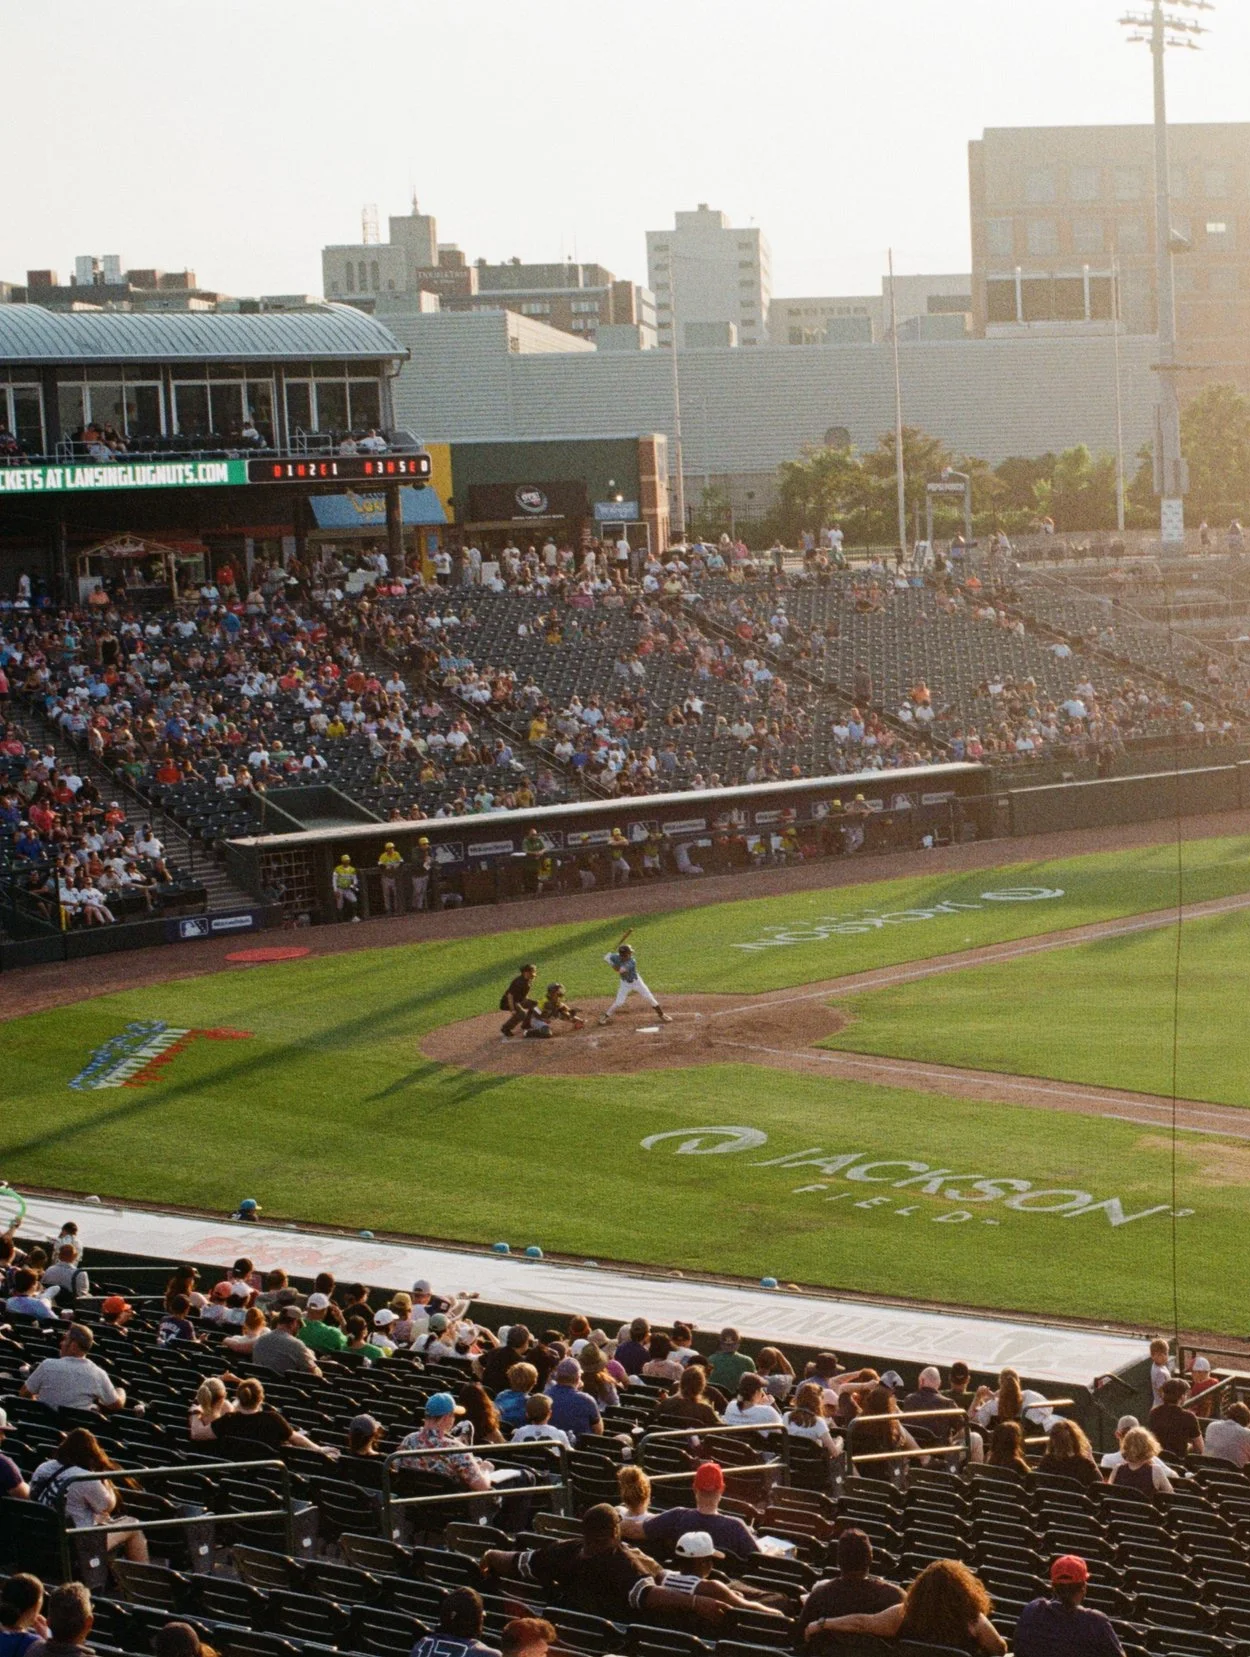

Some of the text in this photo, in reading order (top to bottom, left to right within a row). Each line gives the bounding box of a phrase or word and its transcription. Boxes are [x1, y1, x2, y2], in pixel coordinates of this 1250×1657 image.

[45, 468, 63, 489] AT
[65, 463, 228, 488] LANSINGLUGNUTS.COM
[287, 464, 293, 476] 1
[309, 463, 316, 476] 2
[332, 463, 338, 475] 1
[377, 461, 384, 474] 3
[749, 1148, 1172, 1226] JACKSON
[793, 1184, 972, 1223] FIELD
[700, 1302, 966, 1350] GO NUTS!
